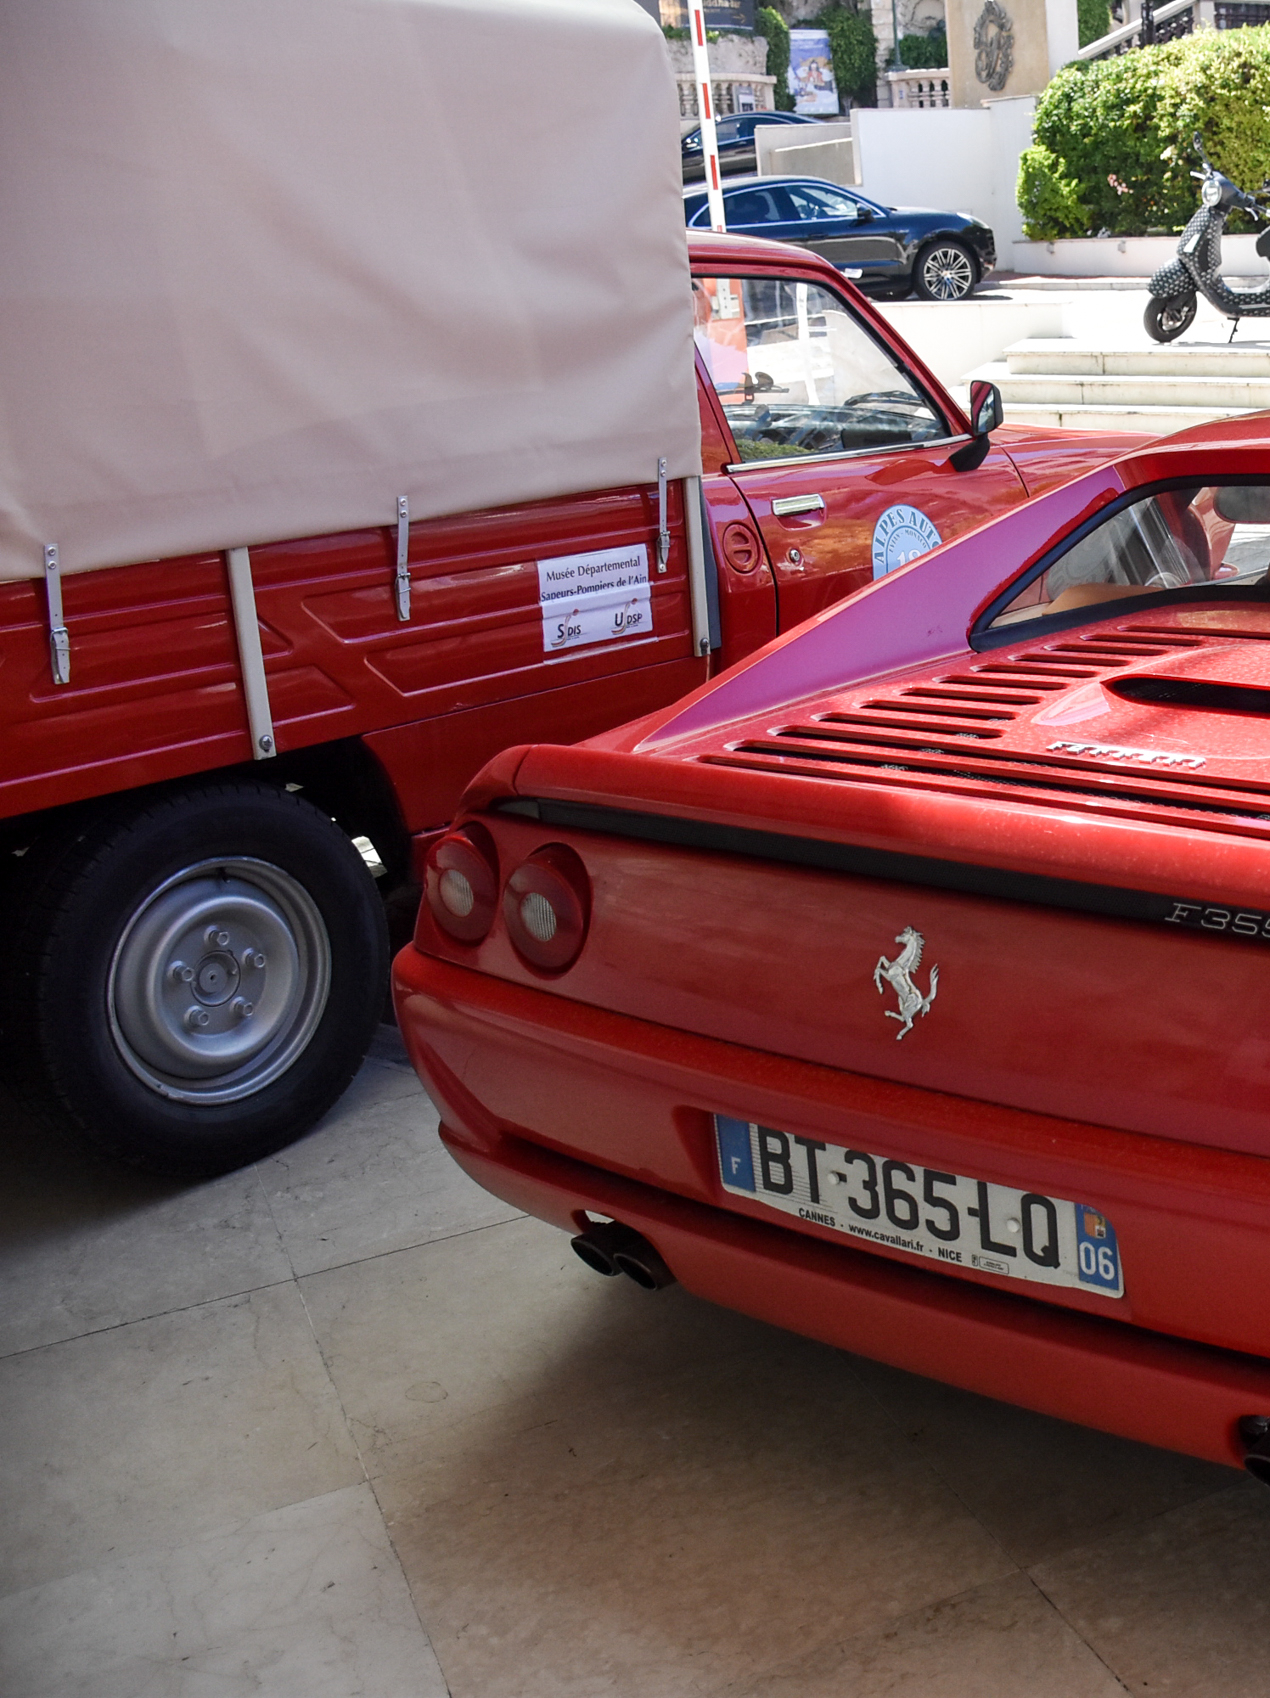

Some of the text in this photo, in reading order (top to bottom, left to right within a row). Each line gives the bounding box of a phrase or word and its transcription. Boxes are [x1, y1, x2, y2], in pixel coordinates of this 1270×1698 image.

[874, 508, 905, 564] ALPES
[541, 574, 647, 602] Sapeurs-Pompiers de l'Ain
[546, 555, 641, 582] Musée Départemental
[731, 1156, 741, 1175] F
[757, 1124, 1060, 1269] BT-365-LQ
[799, 1207, 836, 1227] CANNES
[848, 1224, 924, 1252] www.cavallari.fr
[938, 1246, 962, 1263] NICE
[1079, 1241, 1115, 1281] 06
